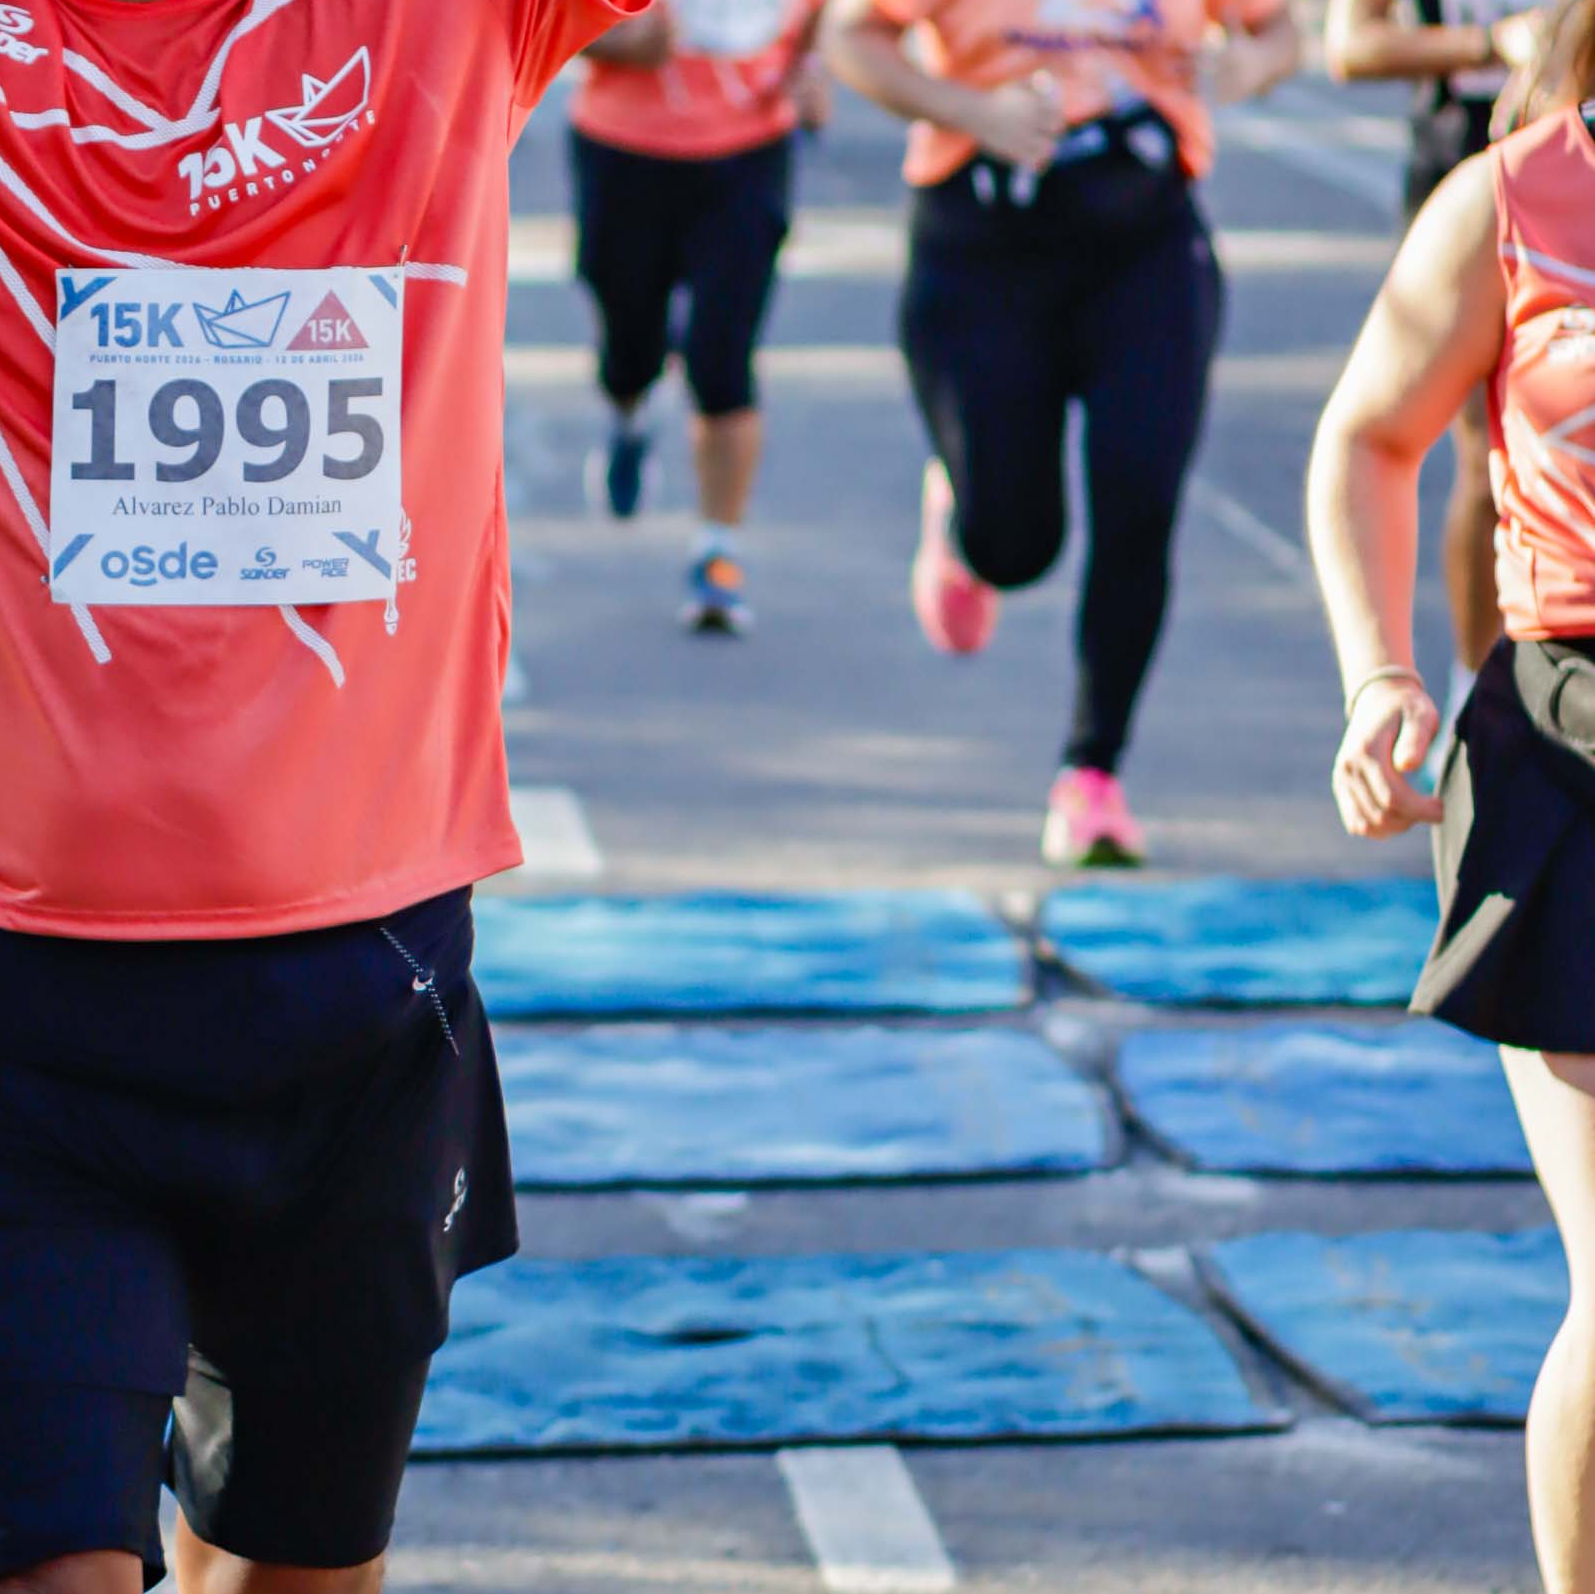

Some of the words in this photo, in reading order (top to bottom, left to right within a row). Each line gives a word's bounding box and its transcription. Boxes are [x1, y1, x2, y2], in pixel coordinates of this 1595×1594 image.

[177, 116, 287, 200] 15K
[189, 169, 295, 217] PUERTO
[89, 301, 184, 348] 15K
[307, 318, 352, 344] 15K
[89, 354, 131, 364] PUERTO
[214, 354, 263, 364] ROSARIO
[70, 377, 385, 484] 1995
[112, 497, 195, 518] Alvarez
[202, 496, 261, 518] Pablo
[267, 495, 343, 517] Damian
[100, 541, 219, 580] osde
